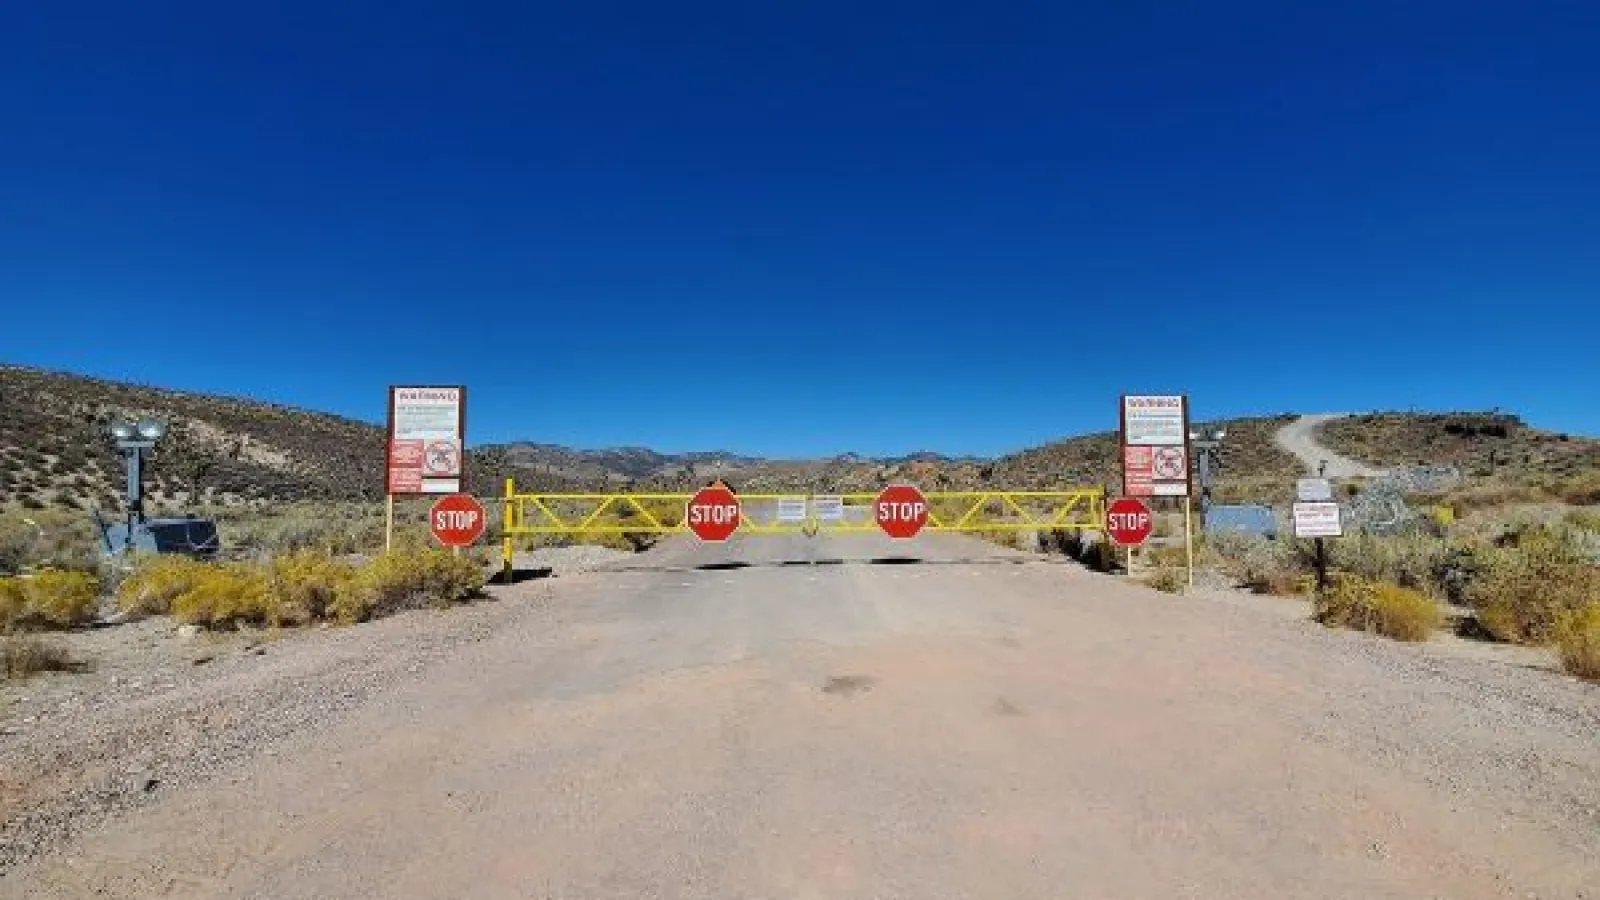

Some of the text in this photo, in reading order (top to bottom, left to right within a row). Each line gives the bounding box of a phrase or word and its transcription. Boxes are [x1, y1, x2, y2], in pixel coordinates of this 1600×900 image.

[436, 510, 478, 530] STOP
[690, 505, 737, 524] STOP
[879, 502, 923, 521] STOP
[1108, 513, 1148, 531] STOP
